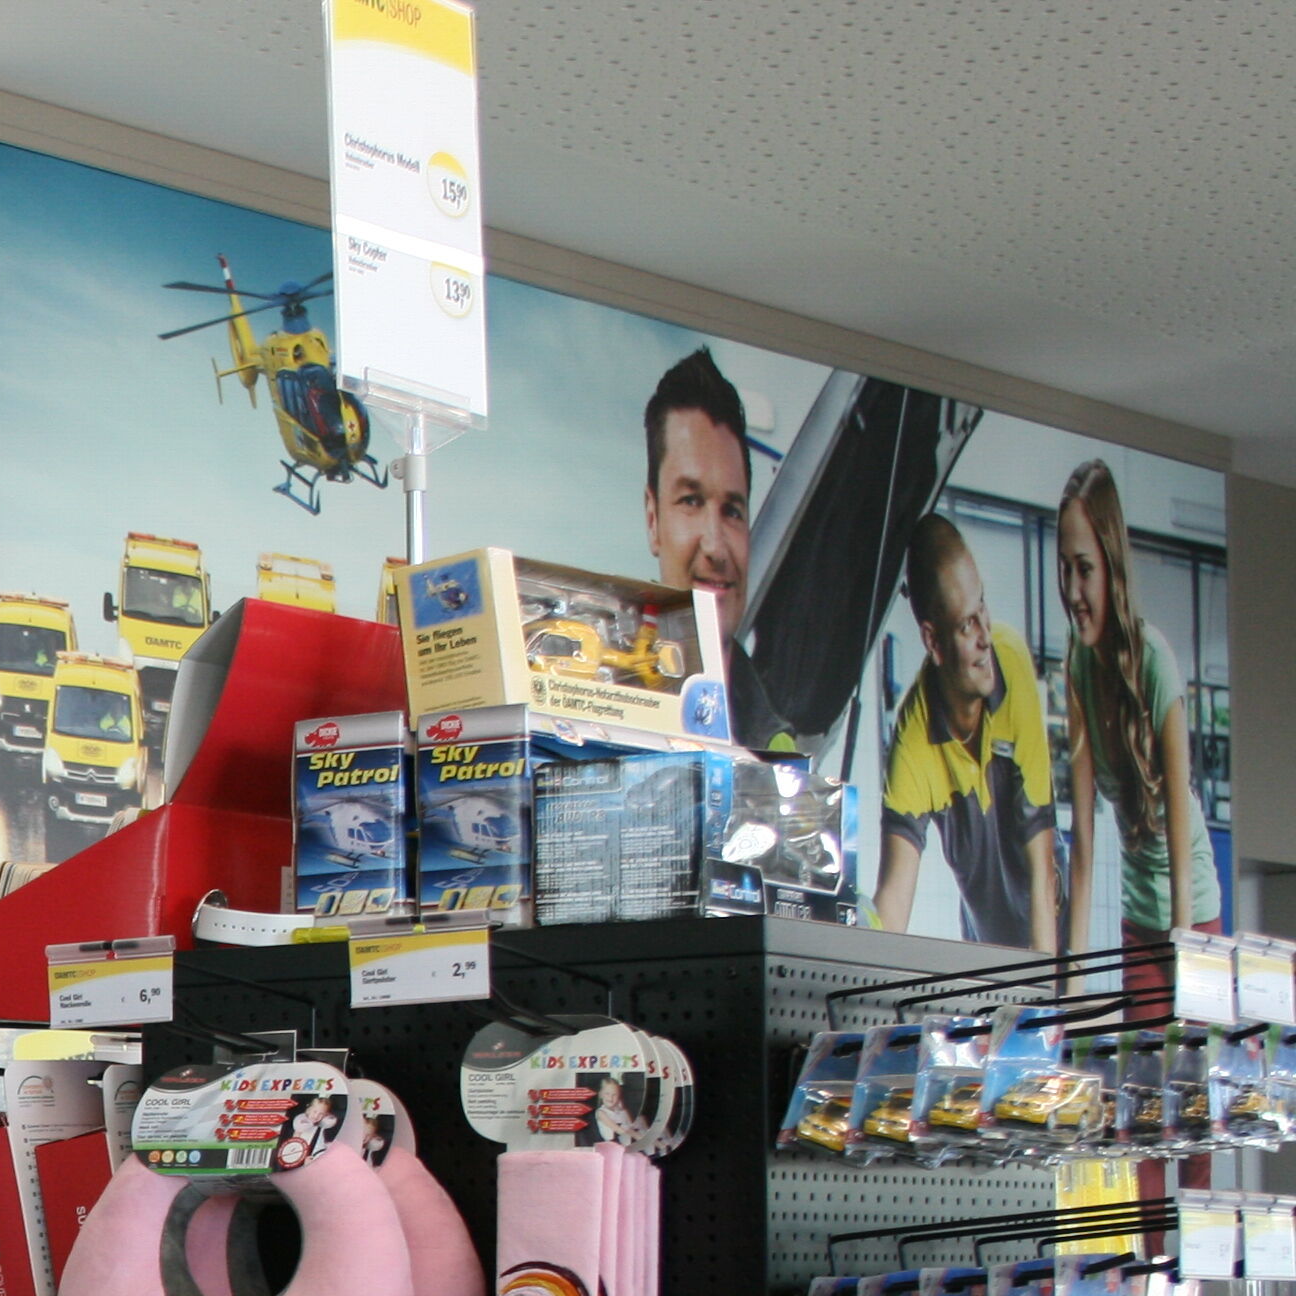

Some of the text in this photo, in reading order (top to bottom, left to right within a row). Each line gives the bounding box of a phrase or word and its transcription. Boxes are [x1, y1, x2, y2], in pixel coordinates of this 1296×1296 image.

[389, 1, 421, 28] SHOP
[416, 627, 463, 644] Sie fliegen
[449, 637, 477, 649] Leben
[309, 751, 356, 770] Sky
[431, 745, 479, 764] Sky
[317, 764, 401, 788] Patrol
[439, 758, 525, 782] Patrol
[452, 961, 476, 979] 2,99
[139, 988, 161, 1004] 6,90
[568, 1054, 639, 1069] EXPERTS
[260, 1078, 336, 1092] EXPERTS
[145, 1098, 169, 1106] COOL
